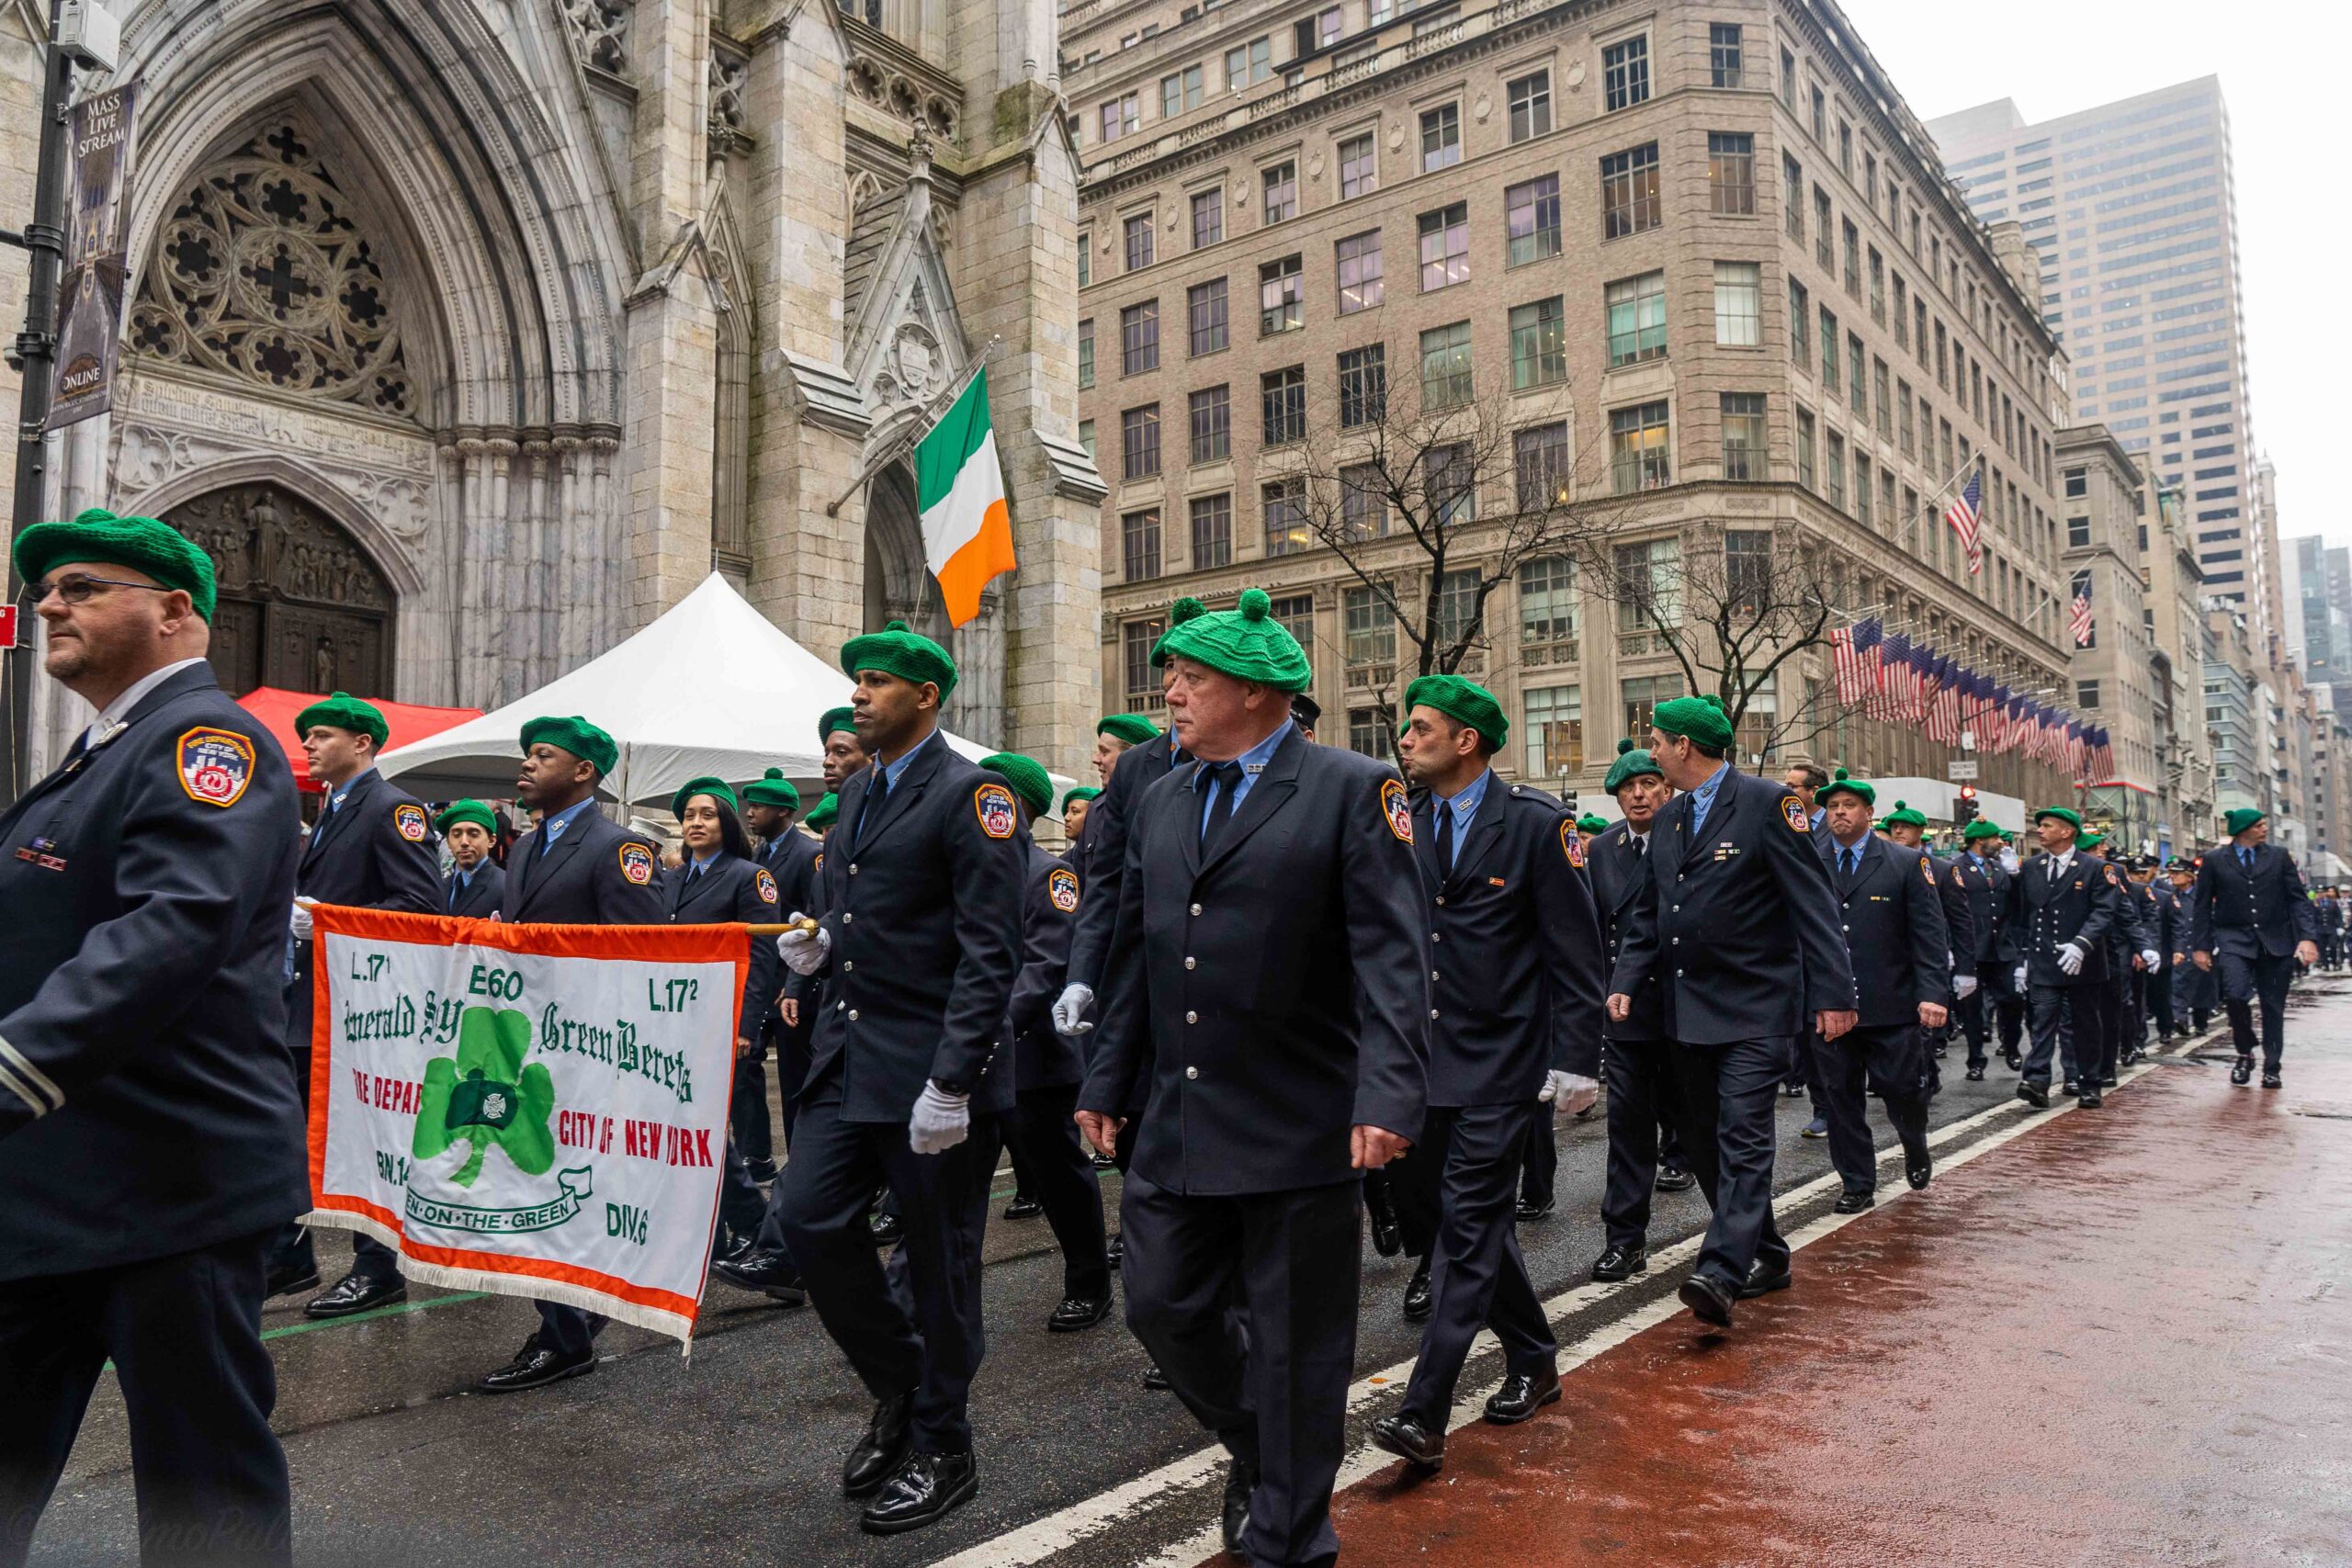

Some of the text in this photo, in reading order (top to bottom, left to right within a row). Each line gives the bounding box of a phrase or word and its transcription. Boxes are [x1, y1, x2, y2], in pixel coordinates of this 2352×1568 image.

[88, 94, 120, 119] MASS
[90, 113, 117, 135] LIVE
[79, 127, 125, 158] STREAM
[63, 367, 100, 390] ONLINE
[537, 1001, 613, 1066] Green
[616, 1019, 693, 1103] Berets
[559, 1110, 595, 1149] CITY
[599, 1116, 614, 1154] OF
[626, 1119, 662, 1160] NEW
[666, 1124, 714, 1167] YORK
